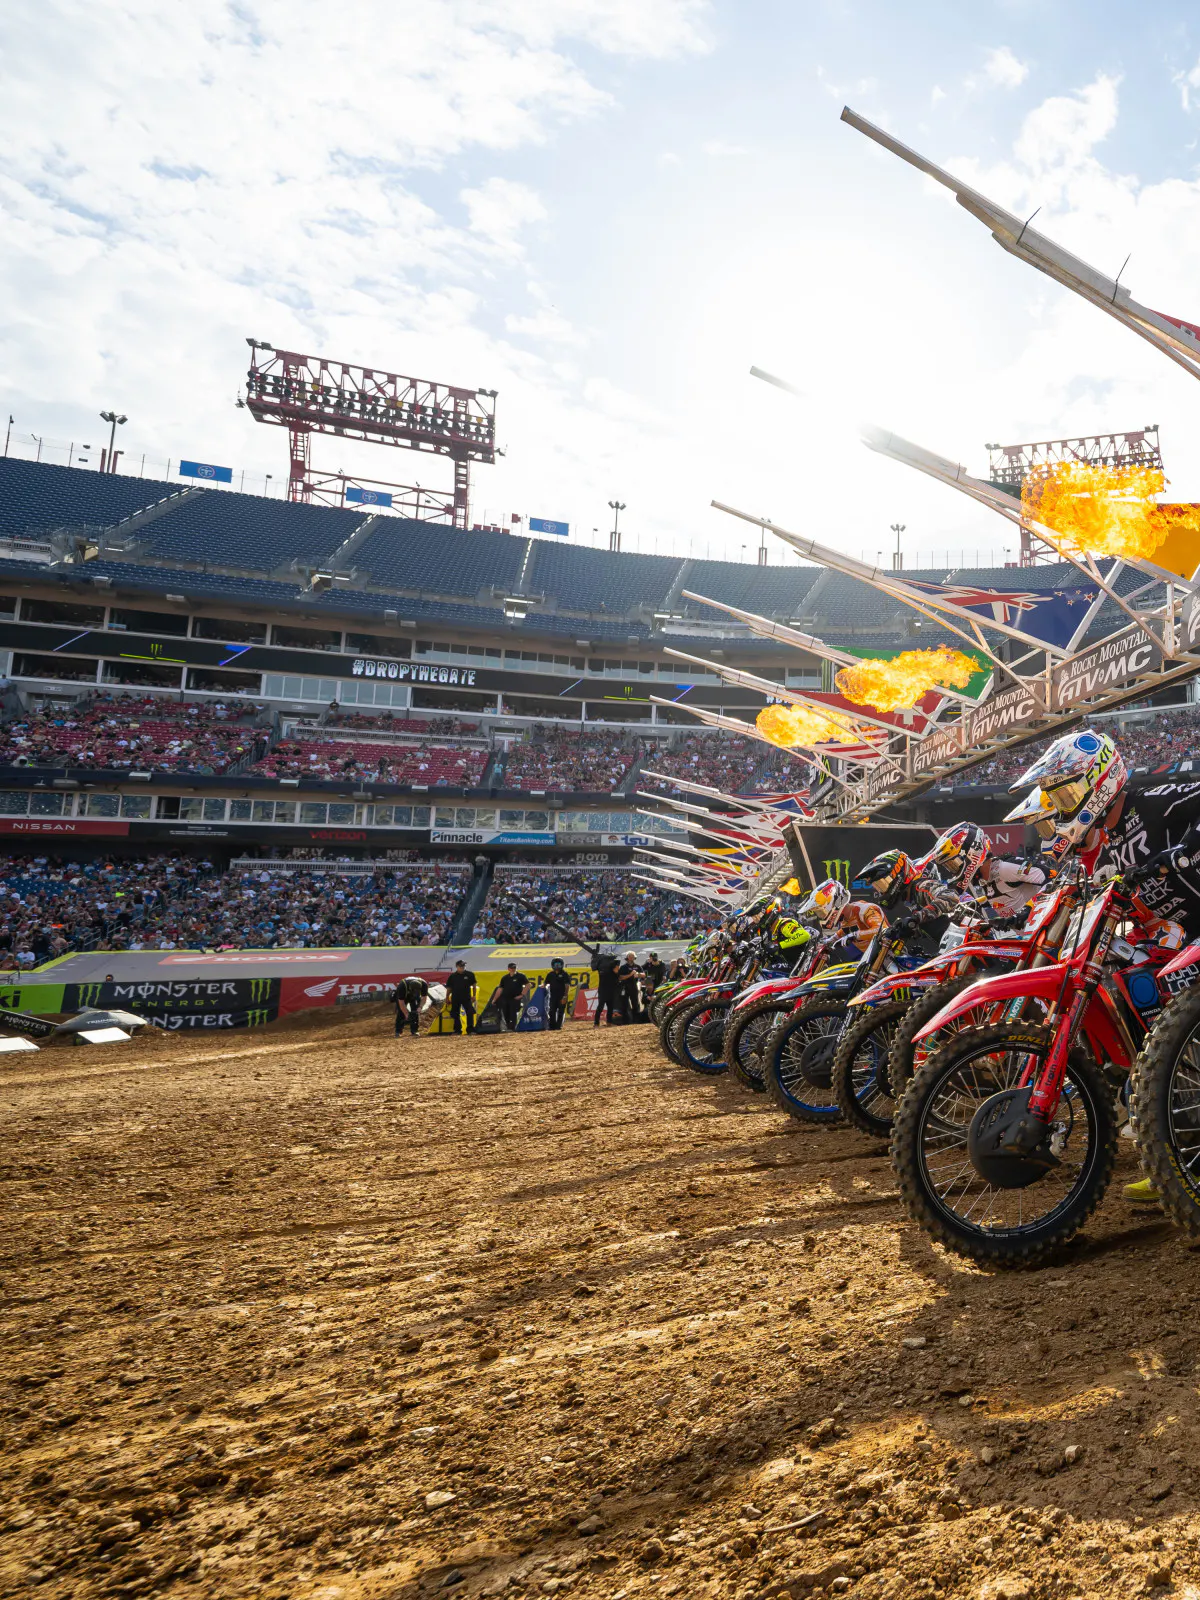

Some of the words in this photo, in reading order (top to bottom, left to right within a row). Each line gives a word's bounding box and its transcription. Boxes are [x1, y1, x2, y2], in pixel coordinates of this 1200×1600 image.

[1070, 653, 1098, 679] ROCKY
[1099, 625, 1153, 664] MOUNTAIN
[1103, 644, 1153, 686] MC
[1000, 698, 1036, 728] MC
[1086, 784, 1108, 811] QUAD
[1091, 787, 1114, 815] LOCK
[12, 822, 76, 832] NISSAN
[309, 829, 367, 841] verizon
[432, 831, 483, 843] Pinnacle
[499, 836, 554, 845] TitansBanking.com
[620, 835, 649, 846] tsu
[576, 853, 608, 861] FLOYD
[212, 954, 343, 963] HONDA
[114, 980, 239, 999] MONSTER
[132, 999, 220, 1008] ENERGY
[1141, 1007, 1162, 1017] HONDA
[4, 1014, 48, 1033] MONSTER
